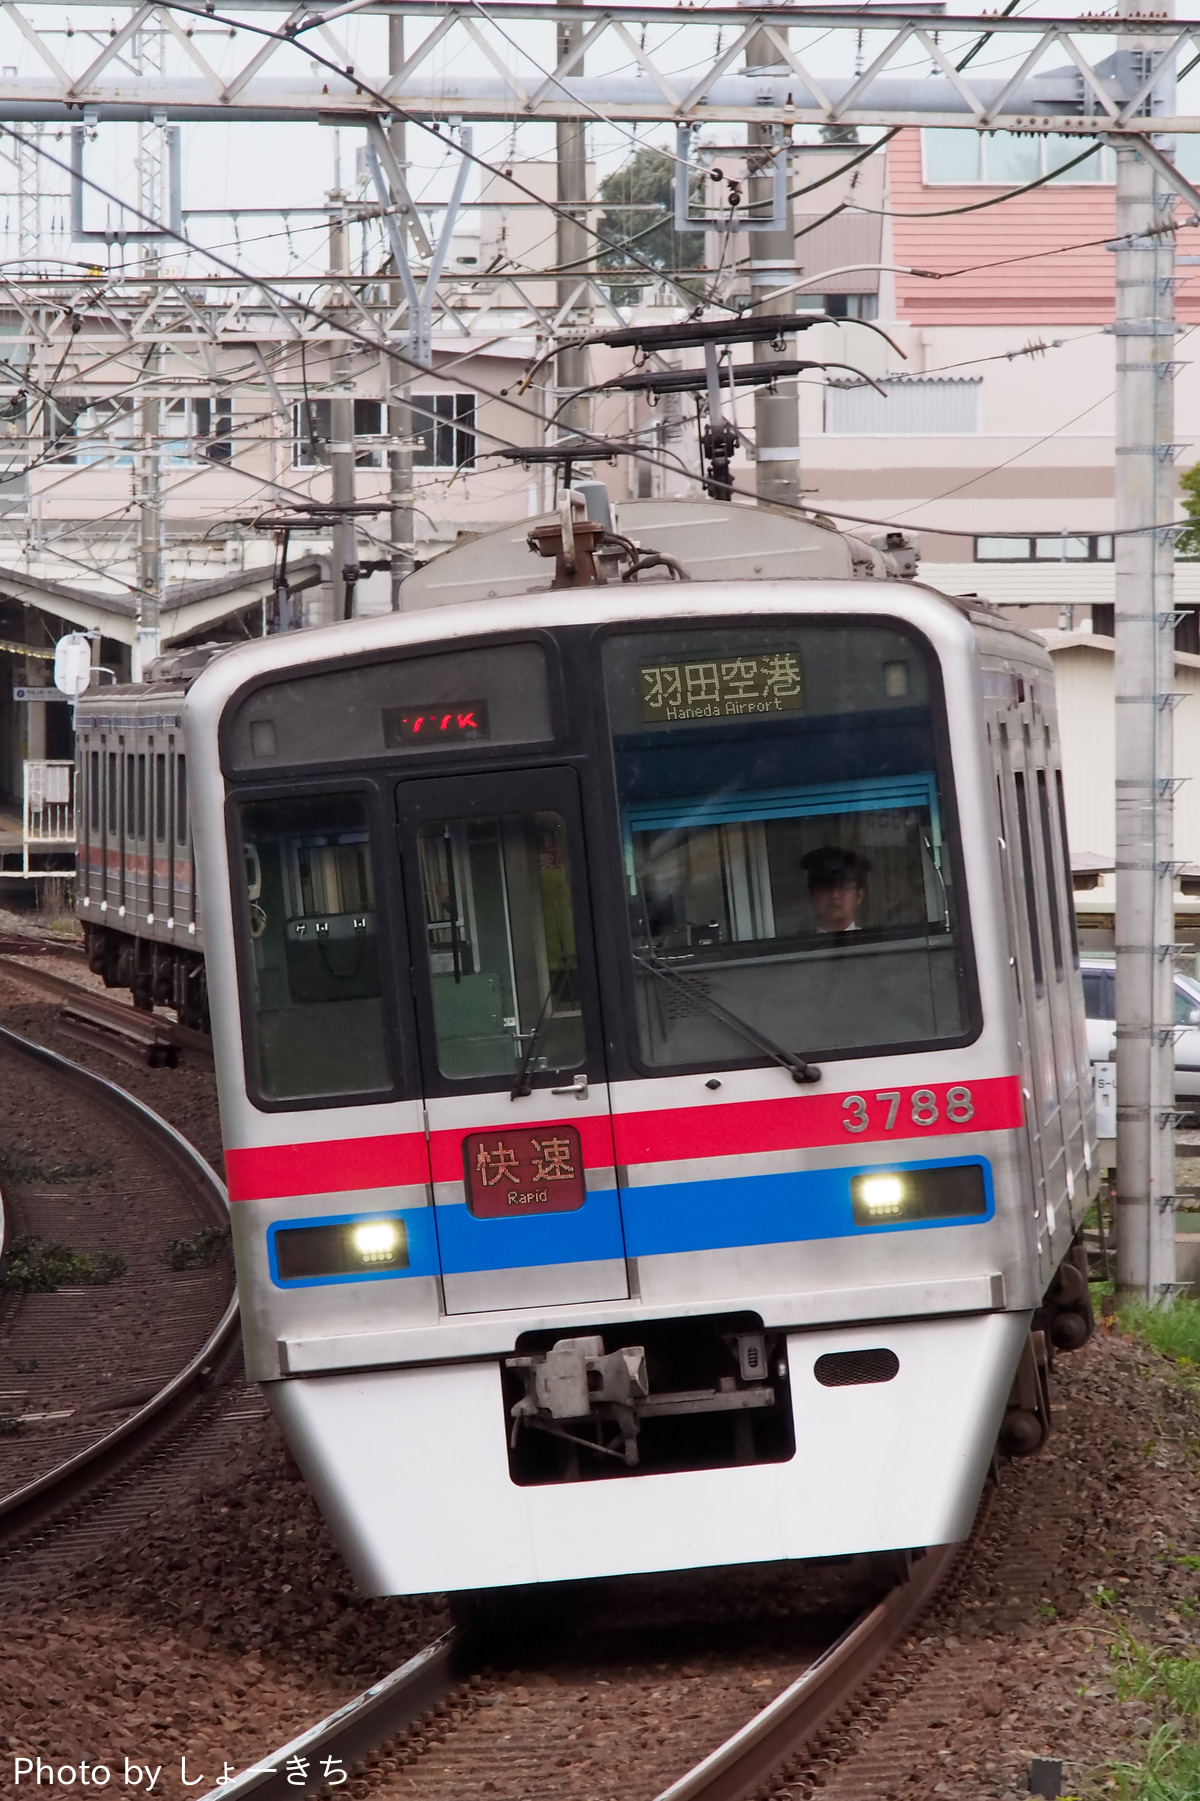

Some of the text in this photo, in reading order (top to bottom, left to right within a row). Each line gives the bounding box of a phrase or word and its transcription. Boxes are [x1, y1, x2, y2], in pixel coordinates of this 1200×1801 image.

[641, 653, 801, 708] 羽田空港
[666, 698, 783, 721] Haneda Airport
[842, 1086, 975, 1133] 3788
[476, 1137, 575, 1186] 快速
[507, 1188, 548, 1205] Rapid
